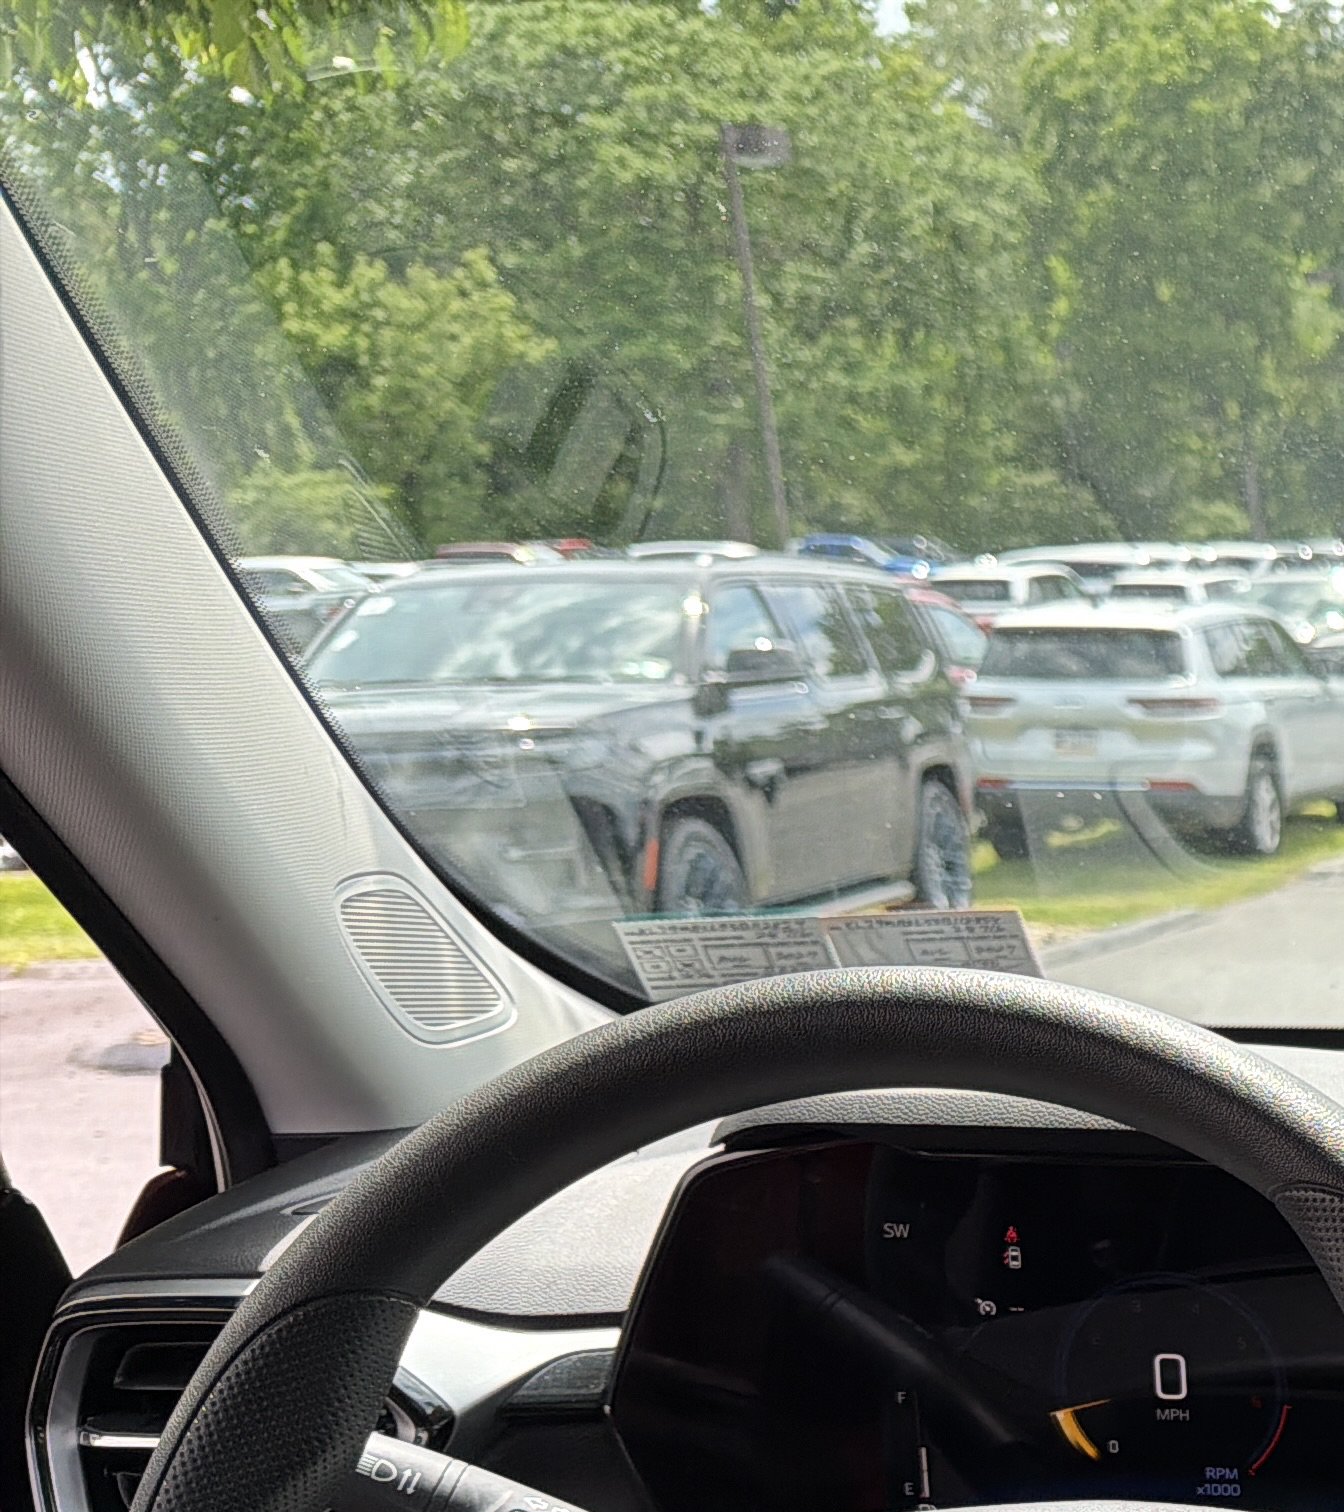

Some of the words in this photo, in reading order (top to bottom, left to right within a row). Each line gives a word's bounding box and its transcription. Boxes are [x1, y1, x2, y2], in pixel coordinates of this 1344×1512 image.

[882, 1222, 911, 1239] SW
[1154, 1353, 1188, 1400] 0
[897, 1391, 907, 1404] F
[1156, 1408, 1190, 1422] MPH
[1205, 1466, 1239, 1480] RPM
[904, 1482, 915, 1496] E
[1197, 1483, 1242, 1497] x1000
